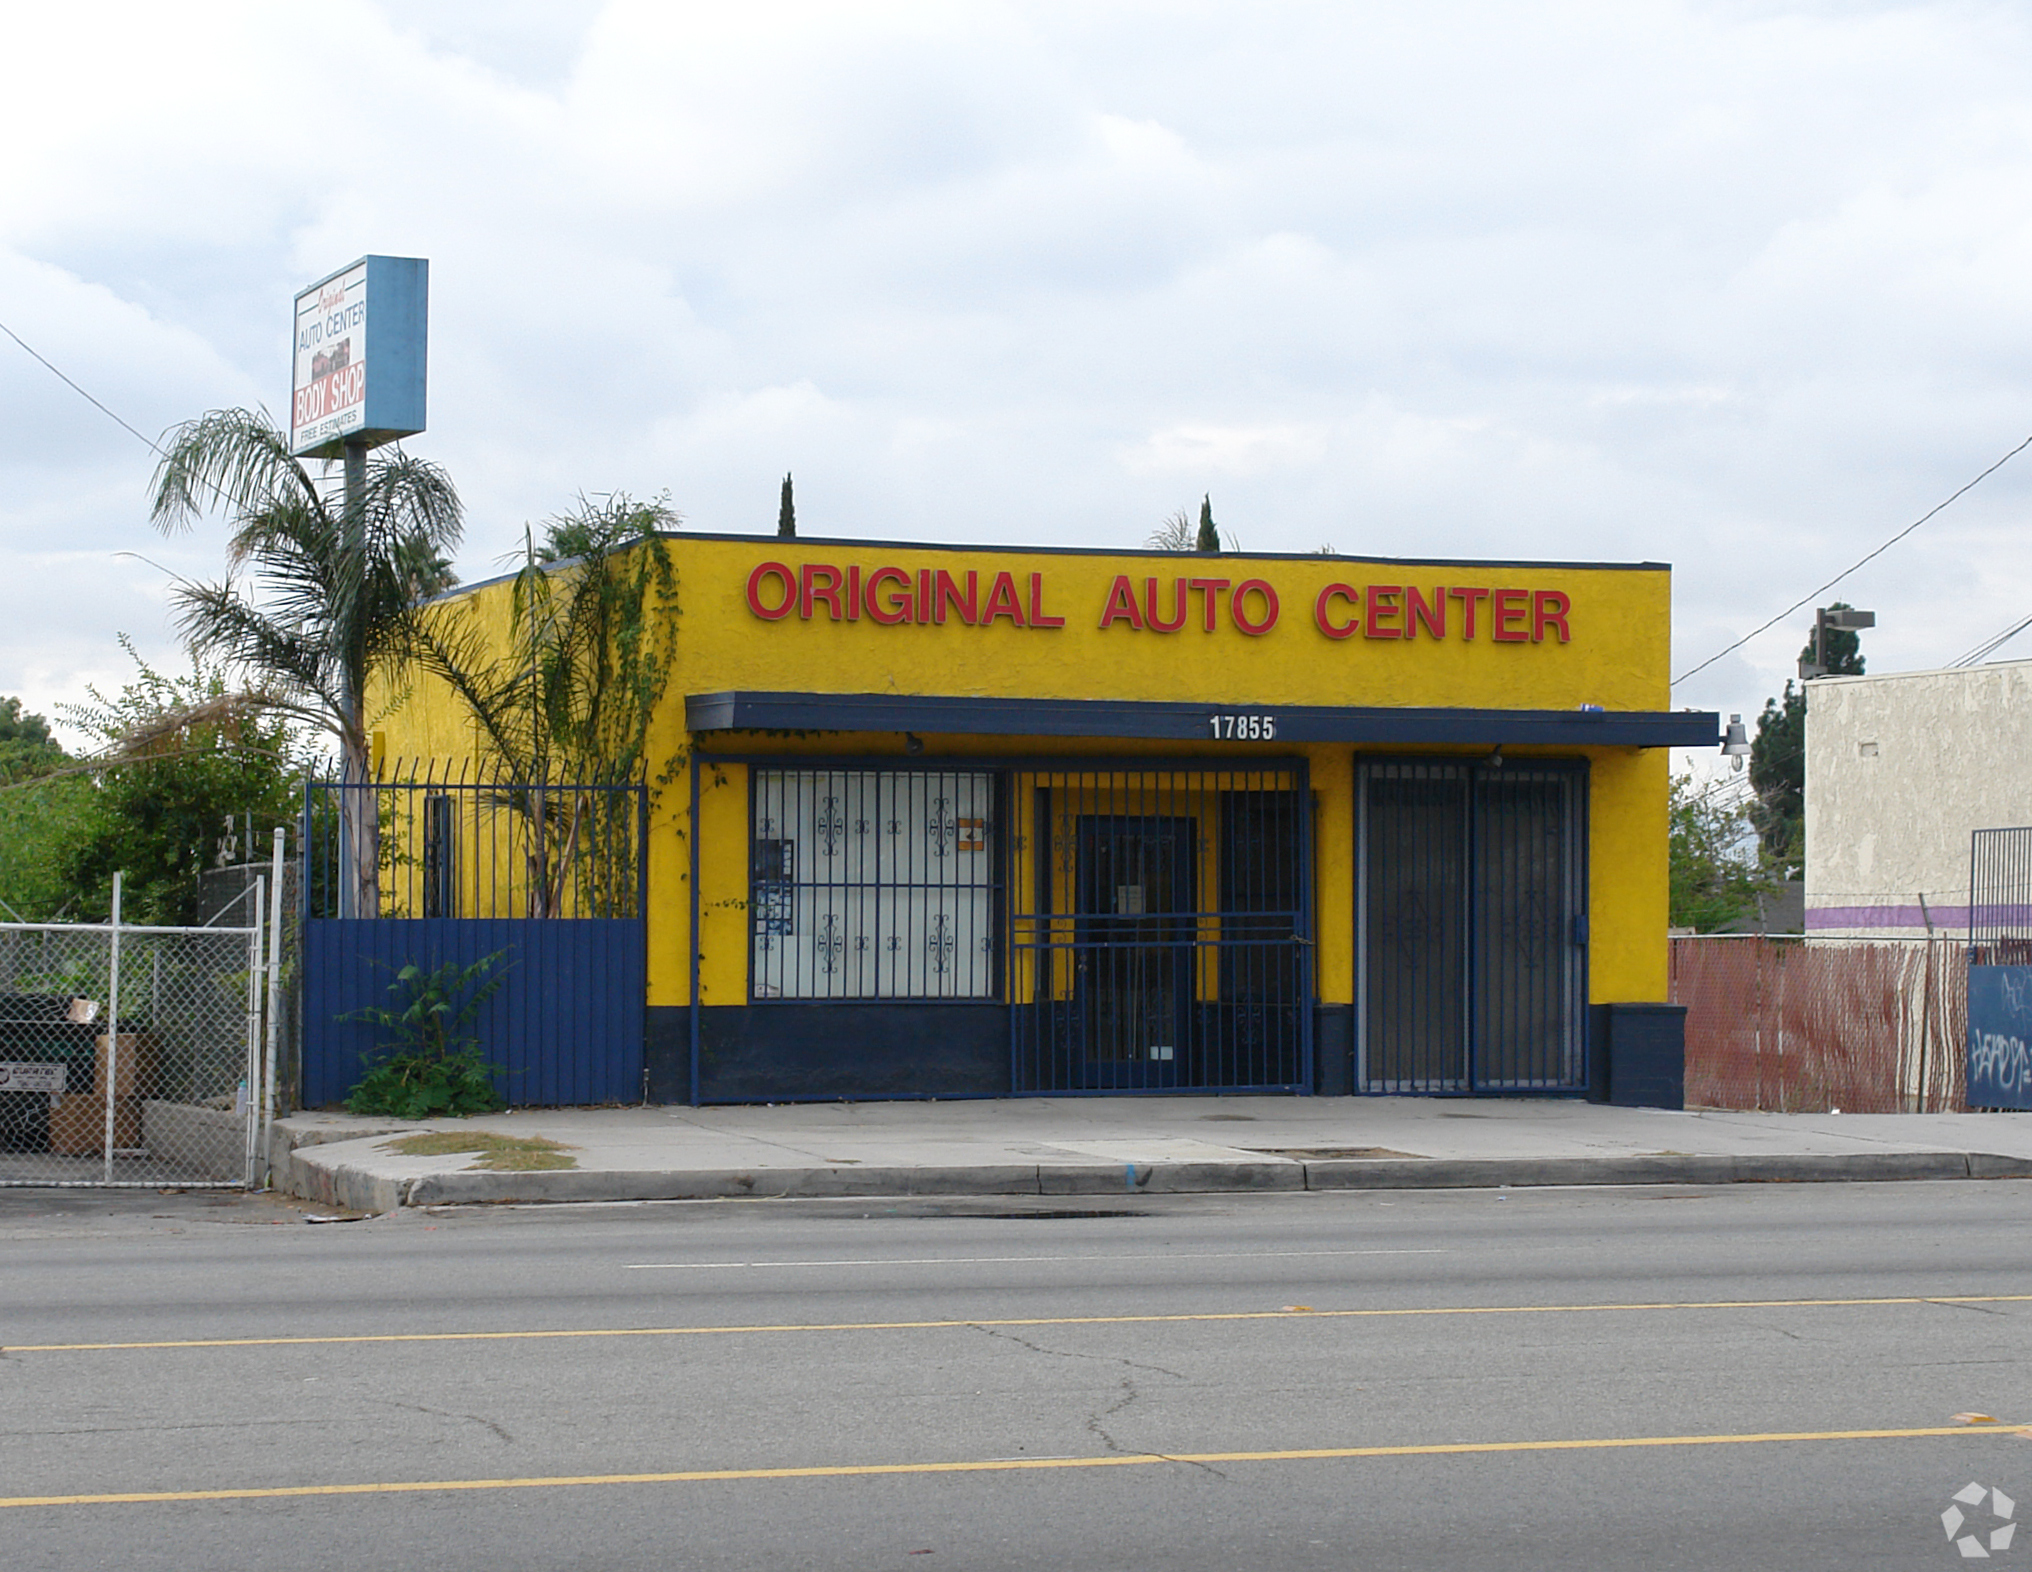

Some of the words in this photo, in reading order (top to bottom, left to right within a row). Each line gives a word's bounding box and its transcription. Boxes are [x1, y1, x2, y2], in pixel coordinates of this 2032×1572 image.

[299, 321, 323, 352] AUTO
[326, 299, 365, 338] CENTER
[297, 380, 328, 427] BODY
[331, 362, 364, 411] SHOP
[301, 426, 318, 443] FREE
[320, 409, 357, 436] ESTIMATES
[747, 561, 1066, 627] ORIGINAL
[1099, 574, 1280, 636] AUTO
[1314, 583, 1571, 643] CENTER
[1209, 715, 1274, 740] 17855
